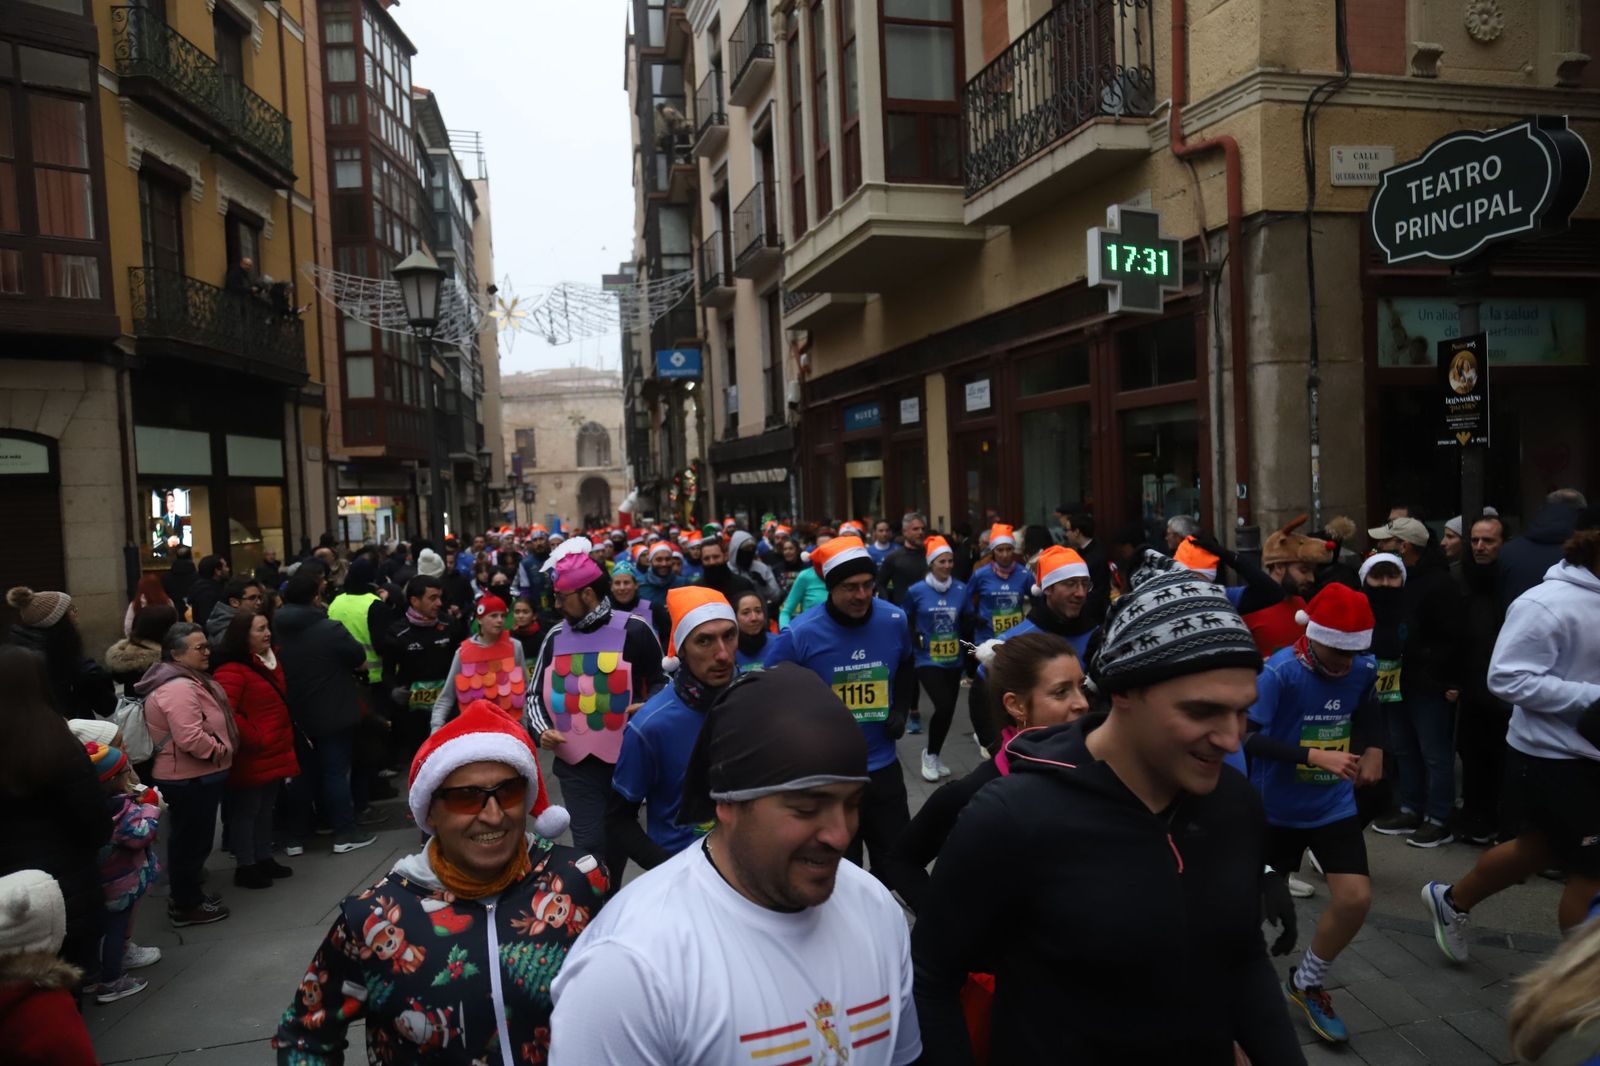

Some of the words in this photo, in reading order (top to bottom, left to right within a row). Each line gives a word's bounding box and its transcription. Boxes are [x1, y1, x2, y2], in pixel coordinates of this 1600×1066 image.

[1353, 152, 1379, 161] CALLE
[1358, 162, 1370, 171] DE
[1406, 154, 1503, 205] TEATRO
[1394, 188, 1523, 245] PRINCIPAL
[1106, 243, 1169, 276] 17:31
[1435, 307, 1461, 321] aliad
[1503, 305, 1539, 321] salud
[994, 616, 1020, 632] 556
[851, 649, 866, 661] 46
[933, 642, 956, 654] 413
[838, 682, 876, 706] 1115
[1323, 698, 1341, 711] 46
